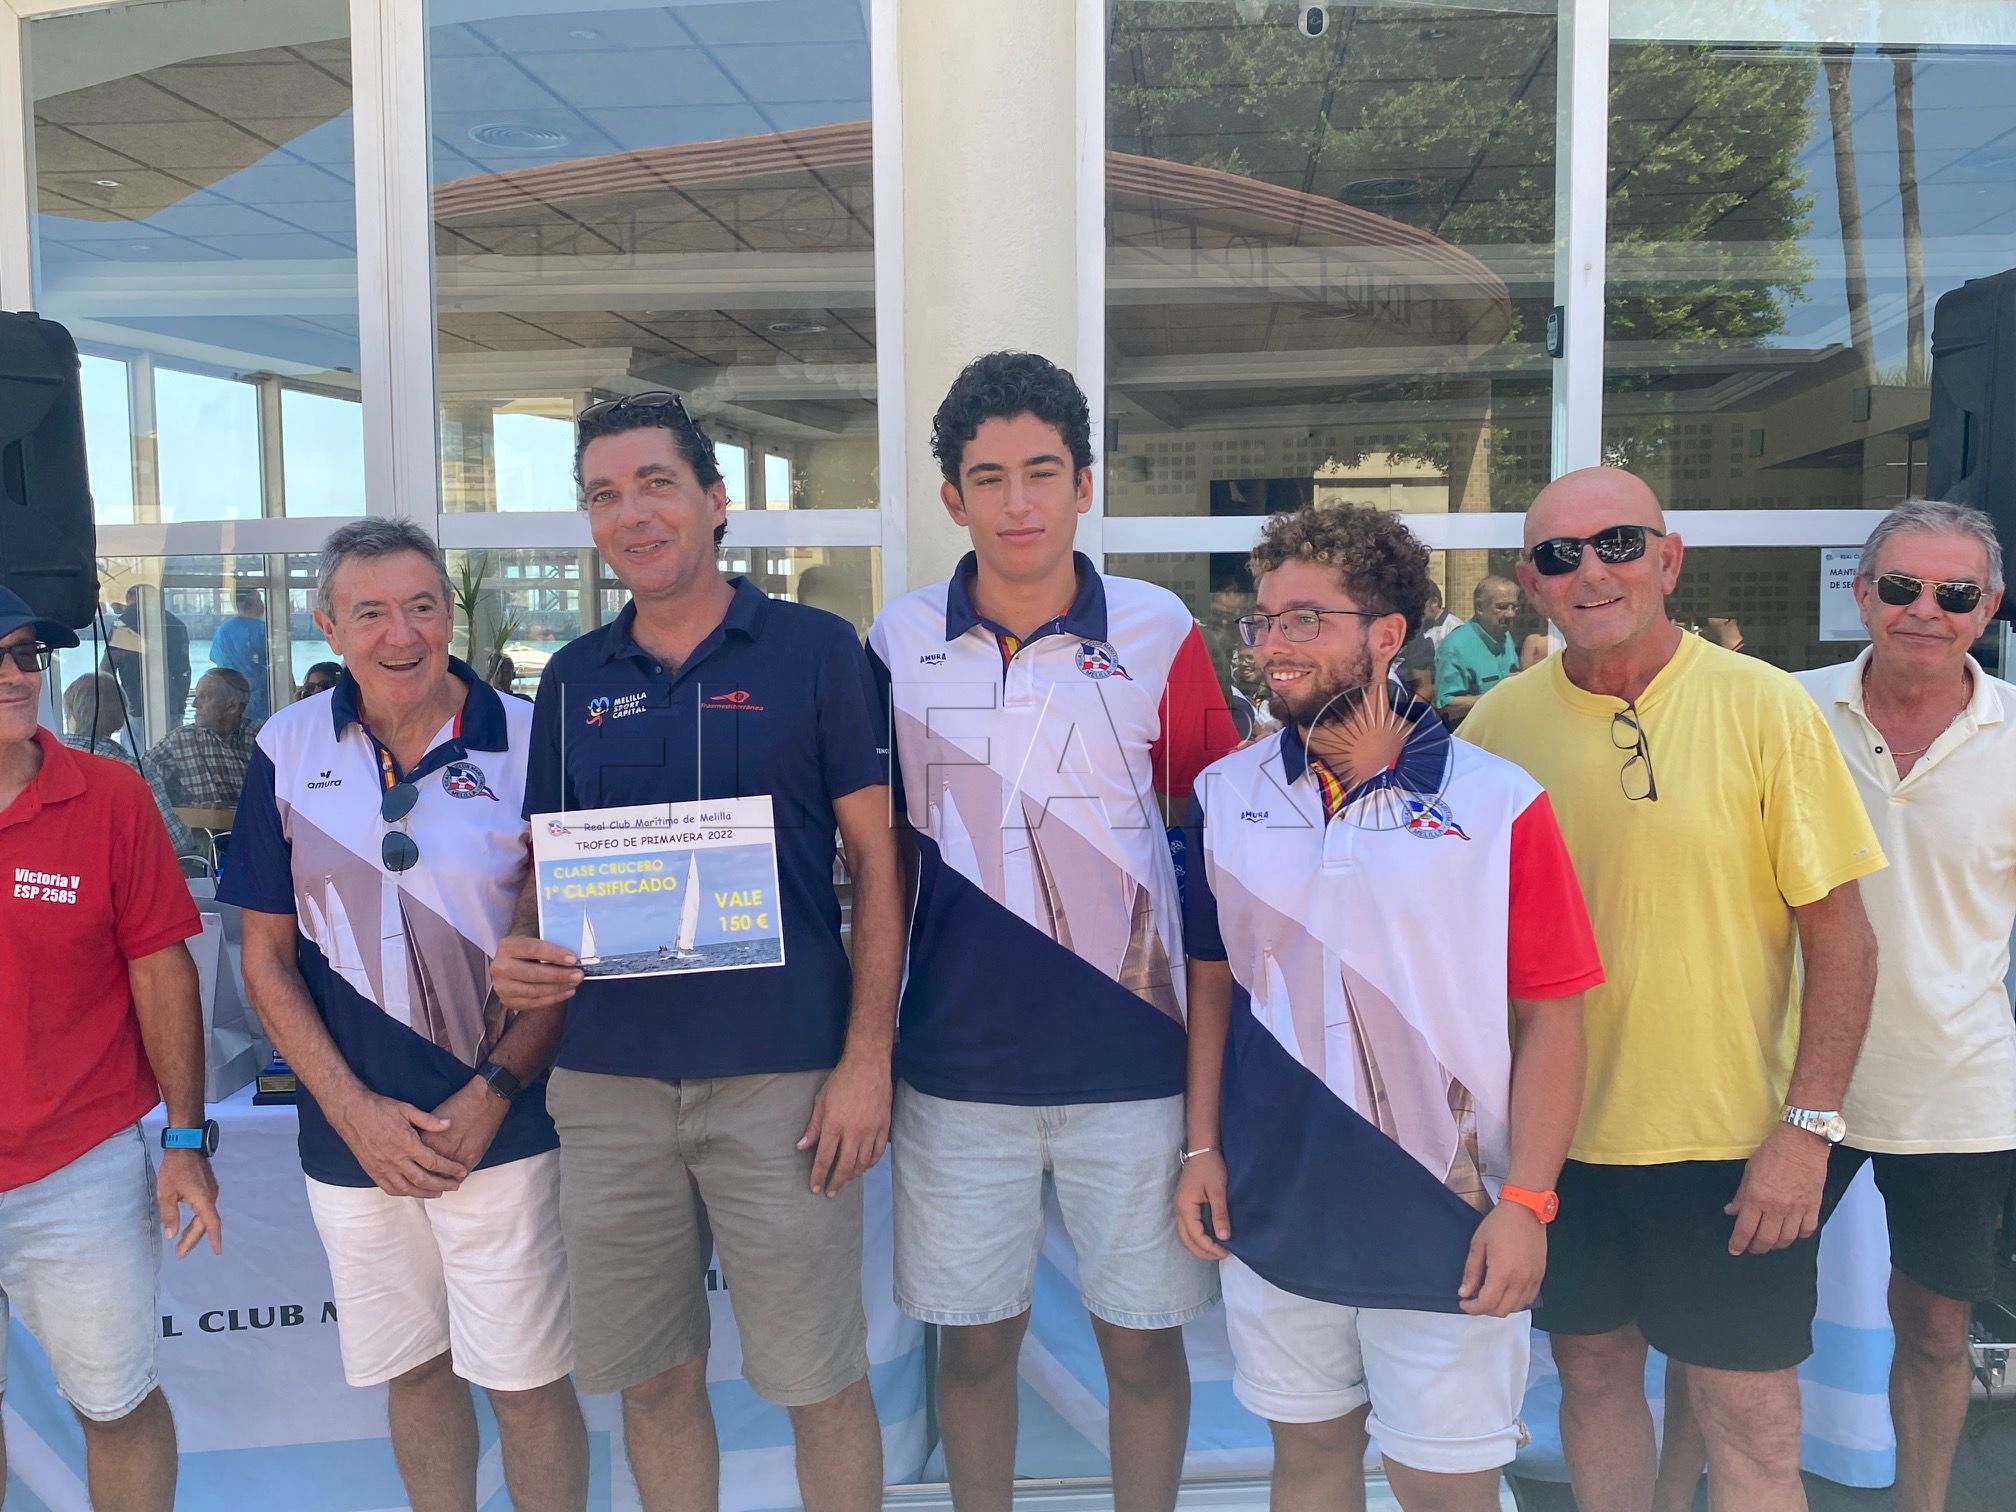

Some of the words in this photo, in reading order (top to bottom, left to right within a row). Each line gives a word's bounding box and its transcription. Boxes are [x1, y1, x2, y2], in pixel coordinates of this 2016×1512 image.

[1830, 581, 1841, 589] DE
[920, 652, 947, 664] AMURA
[613, 691, 647, 706] MELILLA
[613, 701, 640, 713] SPORT
[612, 705, 647, 719] CAPITAL
[307, 779, 342, 789] amura
[584, 821, 605, 832] Real
[610, 820, 631, 830] Club
[635, 817, 679, 829] Marítimo
[683, 814, 695, 824] de
[699, 812, 732, 822] Melilla
[1240, 810, 1269, 820] AMURA
[576, 839, 619, 851] TROFEO
[624, 837, 637, 847] DE
[641, 831, 704, 846] PRIMAVERA
[708, 829, 734, 840] 2022
[15, 867, 69, 888] Victoria
[71, 875, 81, 890] V
[553, 864, 595, 879] CLASE
[599, 859, 664, 876] CRUCERO
[13, 883, 40, 899] ESP
[41, 887, 77, 904] 2585
[563, 876, 677, 899] CLASIFICADO
[714, 889, 763, 909] VALE
[719, 915, 752, 933] 150
[756, 913, 769, 930] €
[161, 1315, 183, 1338] L
[198, 1303, 305, 1334] CLUB
